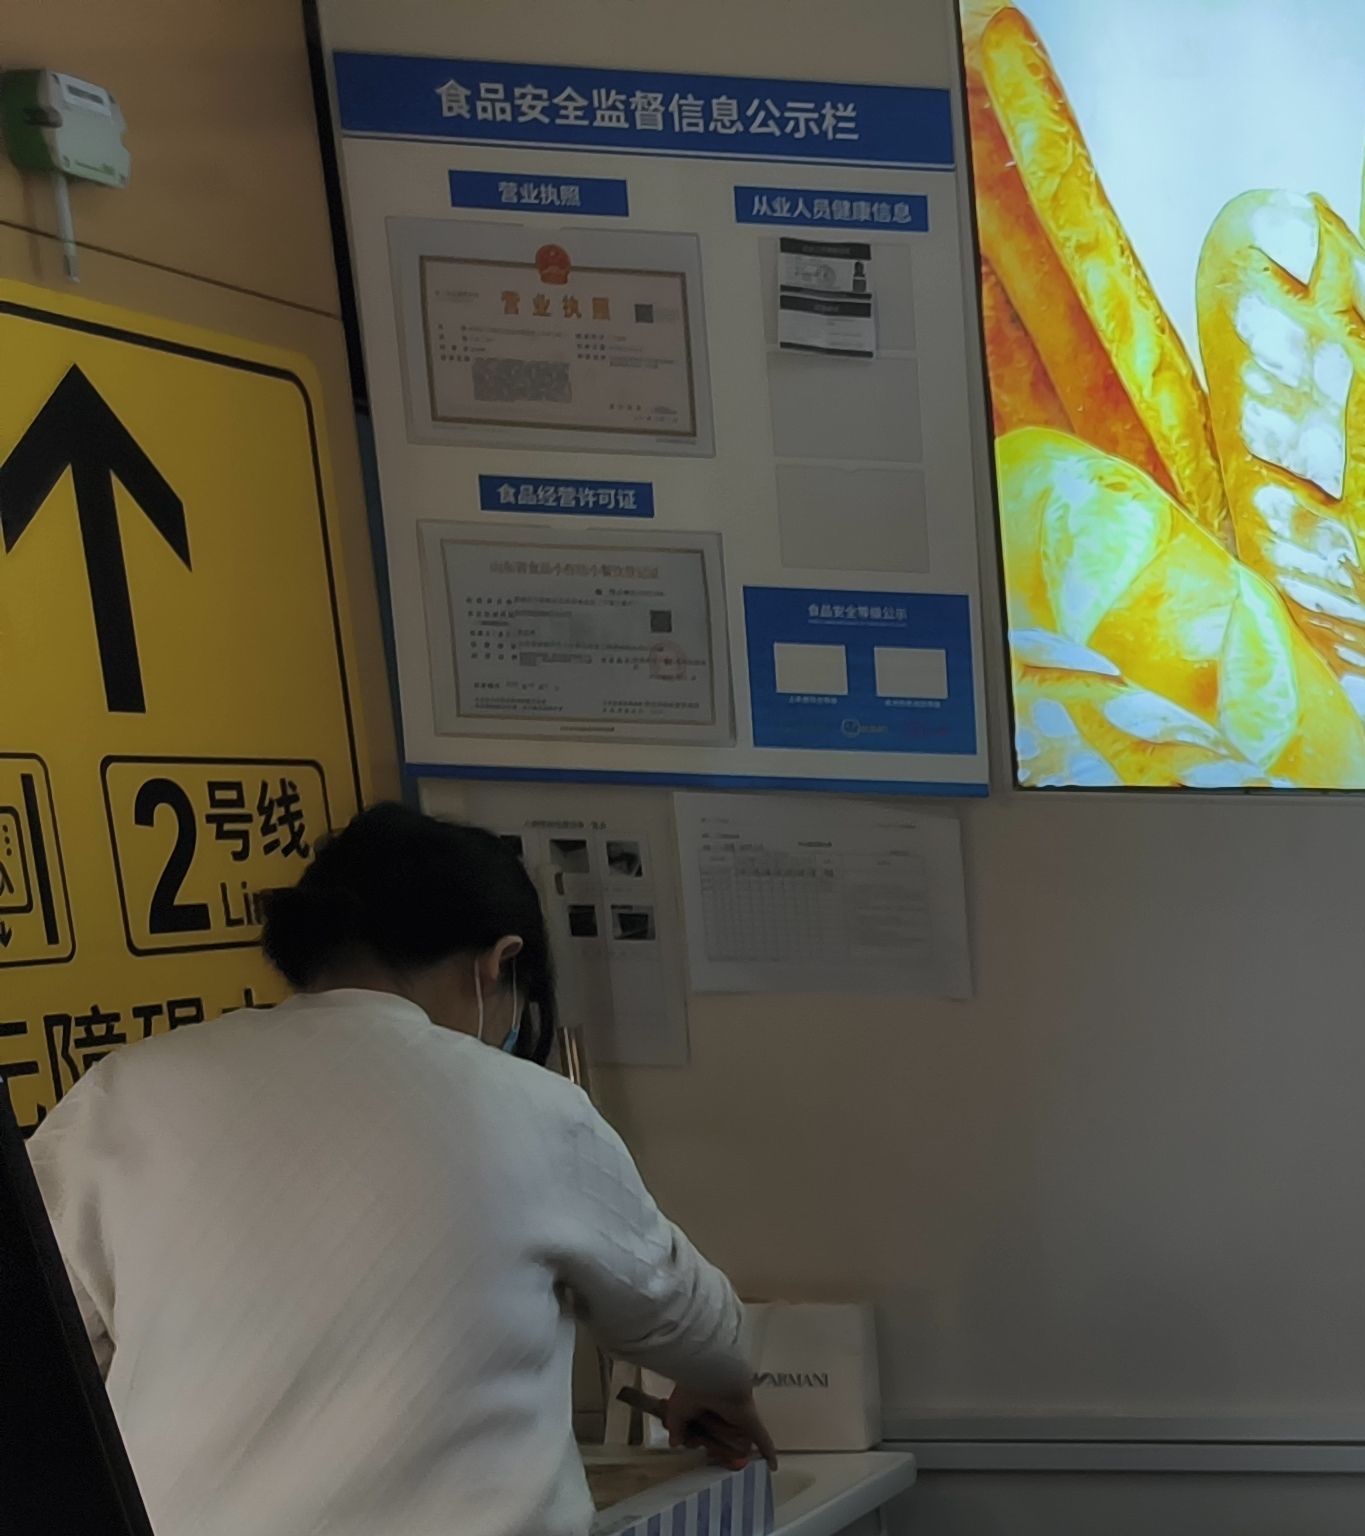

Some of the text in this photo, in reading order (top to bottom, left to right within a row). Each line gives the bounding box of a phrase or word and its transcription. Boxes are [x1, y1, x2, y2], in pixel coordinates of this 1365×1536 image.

[435, 78, 859, 142] 食品安全监督信息公示栏
[498, 181, 581, 207] 营业执照
[752, 195, 912, 224] 从业人员健康信息
[497, 483, 637, 512] 食品经营许可证
[134, 778, 310, 934] 2 号线
